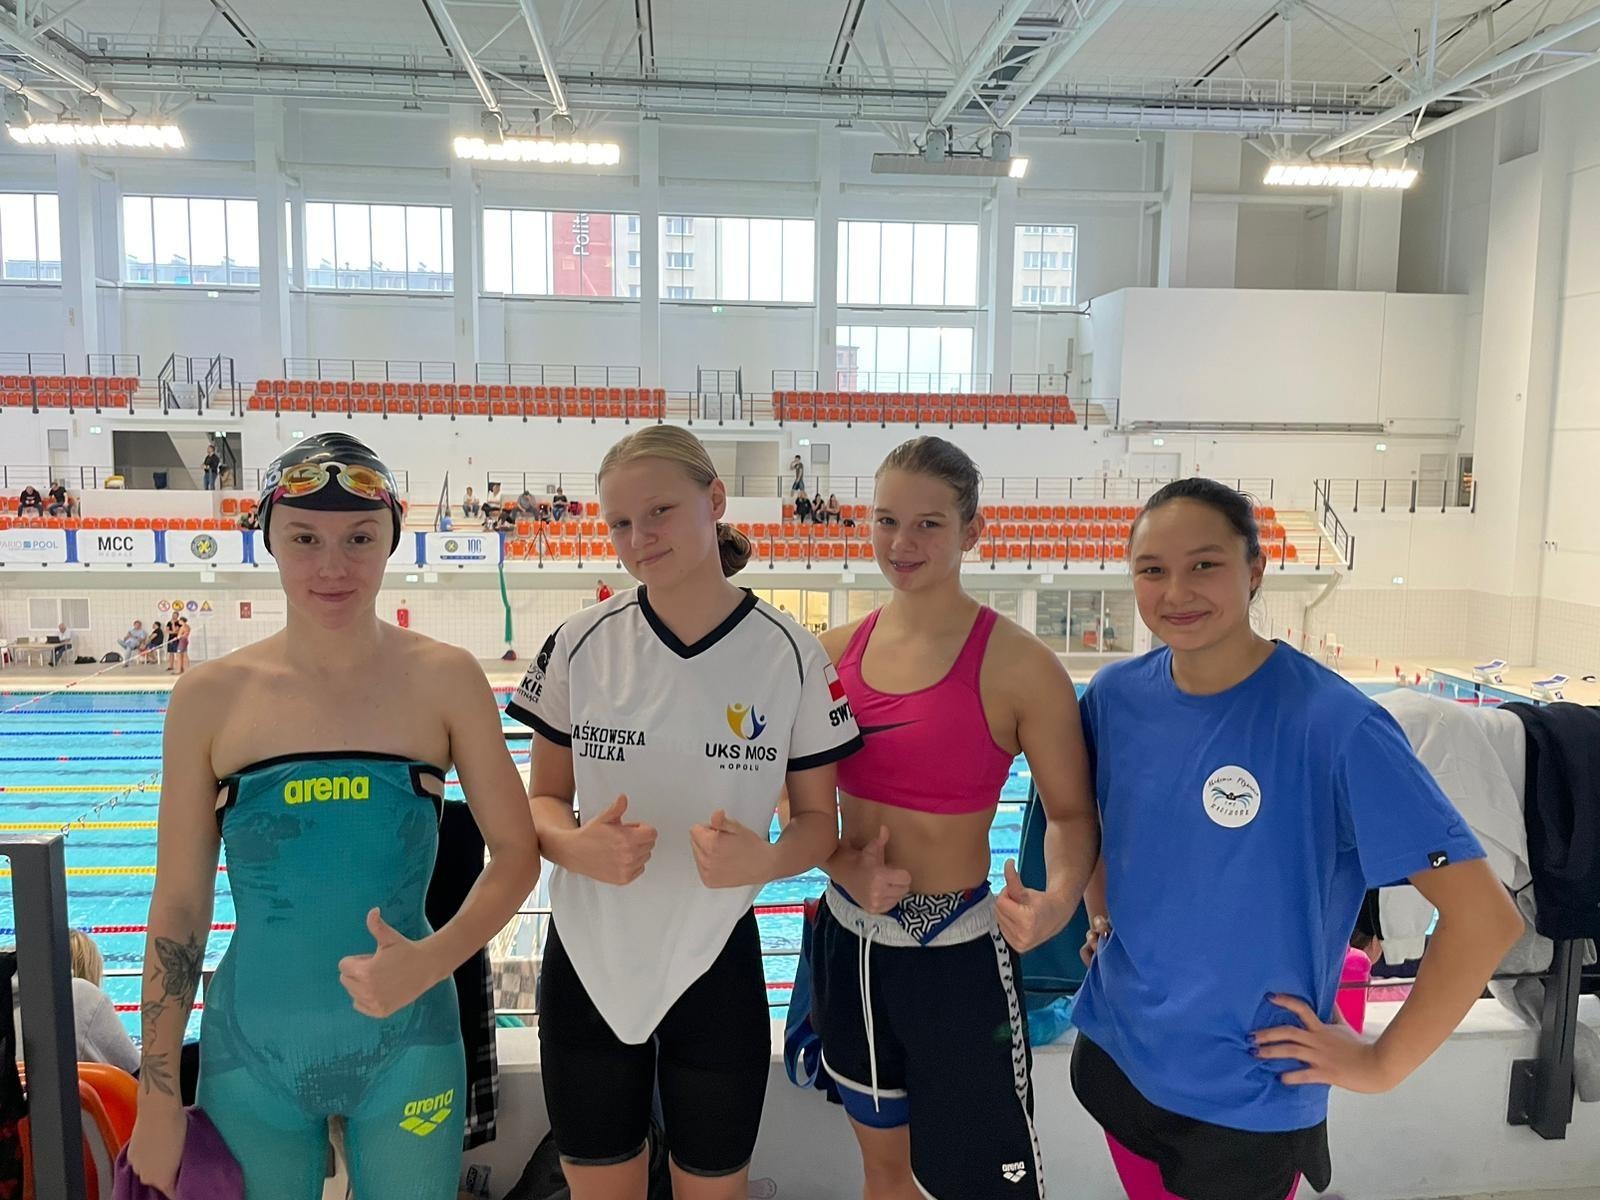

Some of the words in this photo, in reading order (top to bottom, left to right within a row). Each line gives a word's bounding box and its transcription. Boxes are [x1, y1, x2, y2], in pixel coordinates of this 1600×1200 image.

[33, 541, 58, 549] POOL
[98, 536, 134, 551] MCC
[571, 720, 646, 746] AŚKOWSKA
[579, 741, 625, 762] JULKA
[705, 742, 741, 760] UKS
[745, 744, 777, 762] MOS
[728, 763, 759, 771] OPOLU
[284, 775, 369, 805] arena
[404, 1087, 454, 1117] arena
